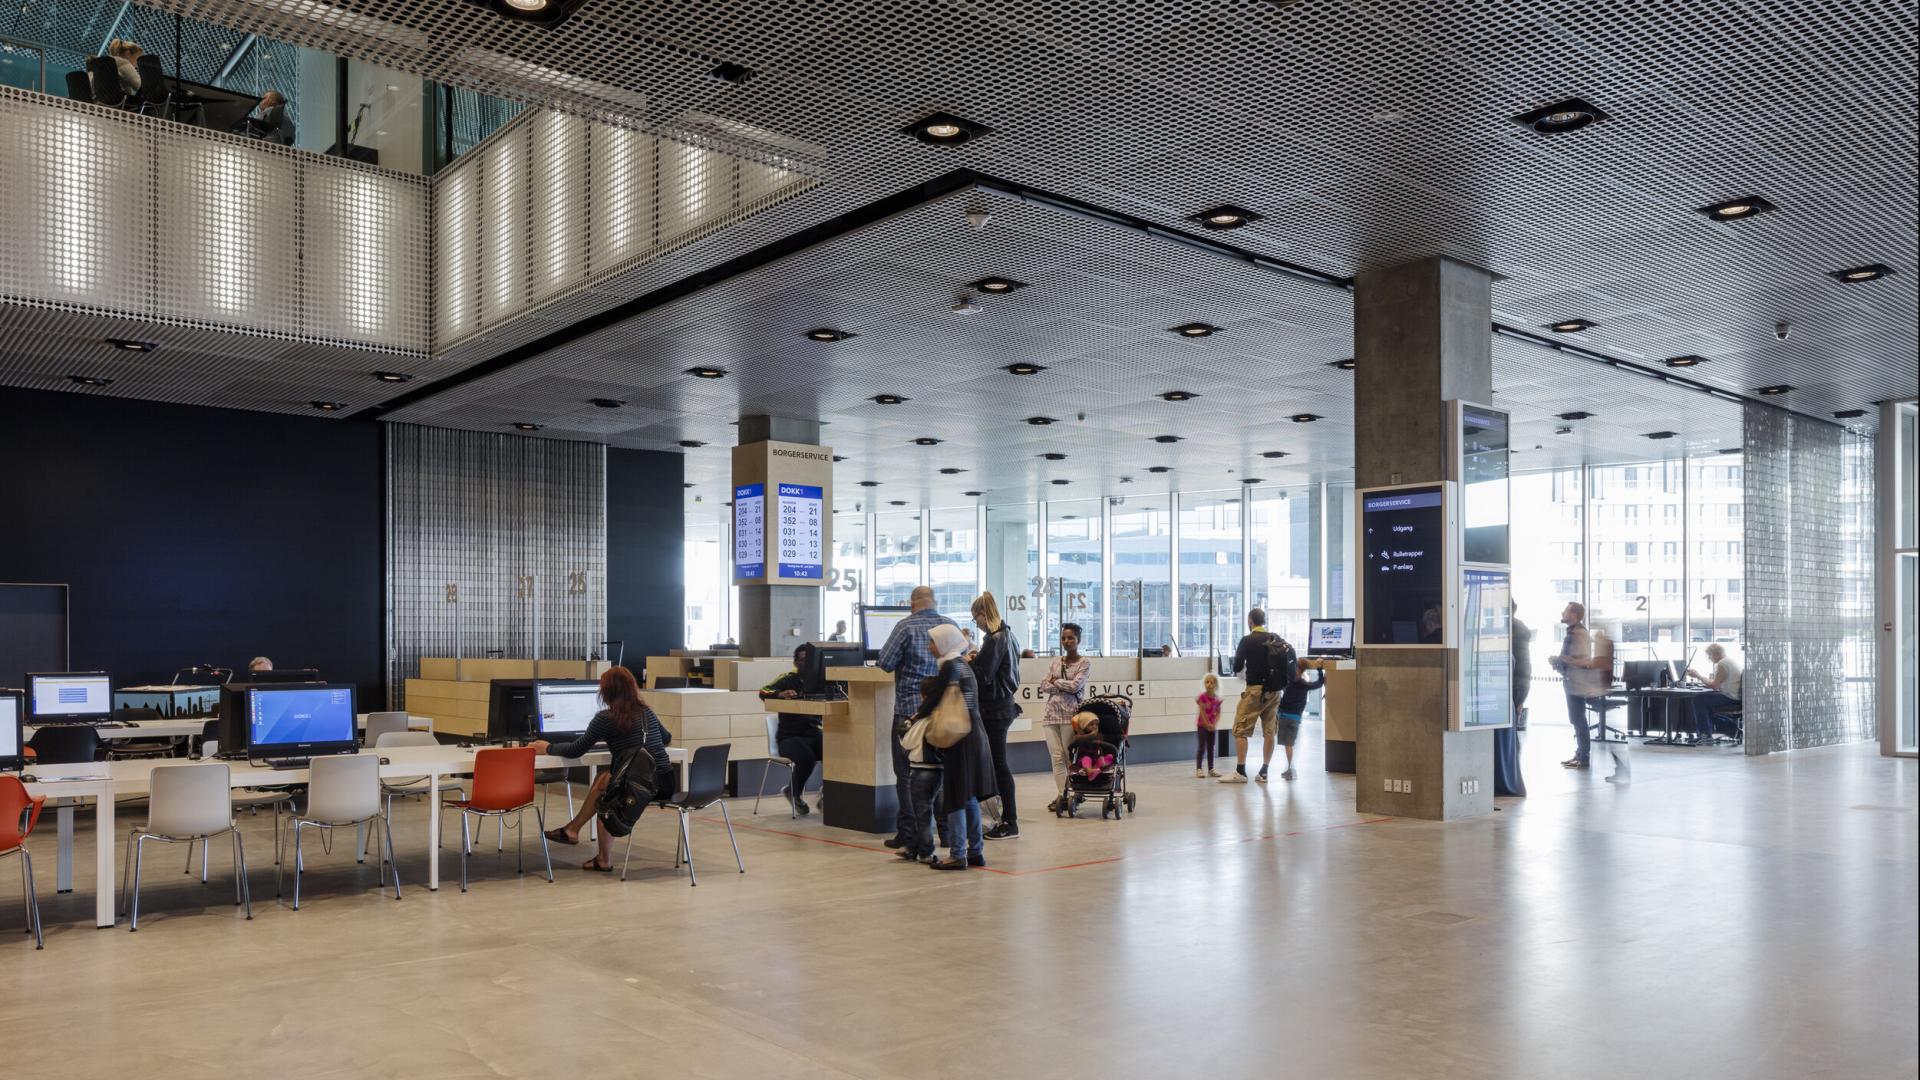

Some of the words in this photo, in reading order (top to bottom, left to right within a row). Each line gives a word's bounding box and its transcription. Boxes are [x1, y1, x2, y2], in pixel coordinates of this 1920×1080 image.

[772, 449, 829, 461] BORGERSERVICE
[781, 486, 804, 495] DOKK1
[1367, 499, 1412, 508] BORGERSERVICE
[783, 505, 796, 514] 204
[808, 507, 817, 516] 21
[783, 516, 797, 525] 352
[808, 518, 818, 526] 08
[783, 527, 796, 536] 031
[809, 529, 818, 537] 14
[1392, 525, 1414, 533] Udgang
[783, 538, 797, 547] 030
[809, 540, 818, 548] 13
[783, 549, 797, 558] 029
[809, 551, 818, 559] 12
[826, 568, 857, 592] 25
[1031, 576, 1057, 598] 24
[1116, 580, 1139, 601] 23
[1189, 583, 1209, 602] 22
[1635, 595, 1648, 611] 2
[1702, 593, 1712, 610] 1
